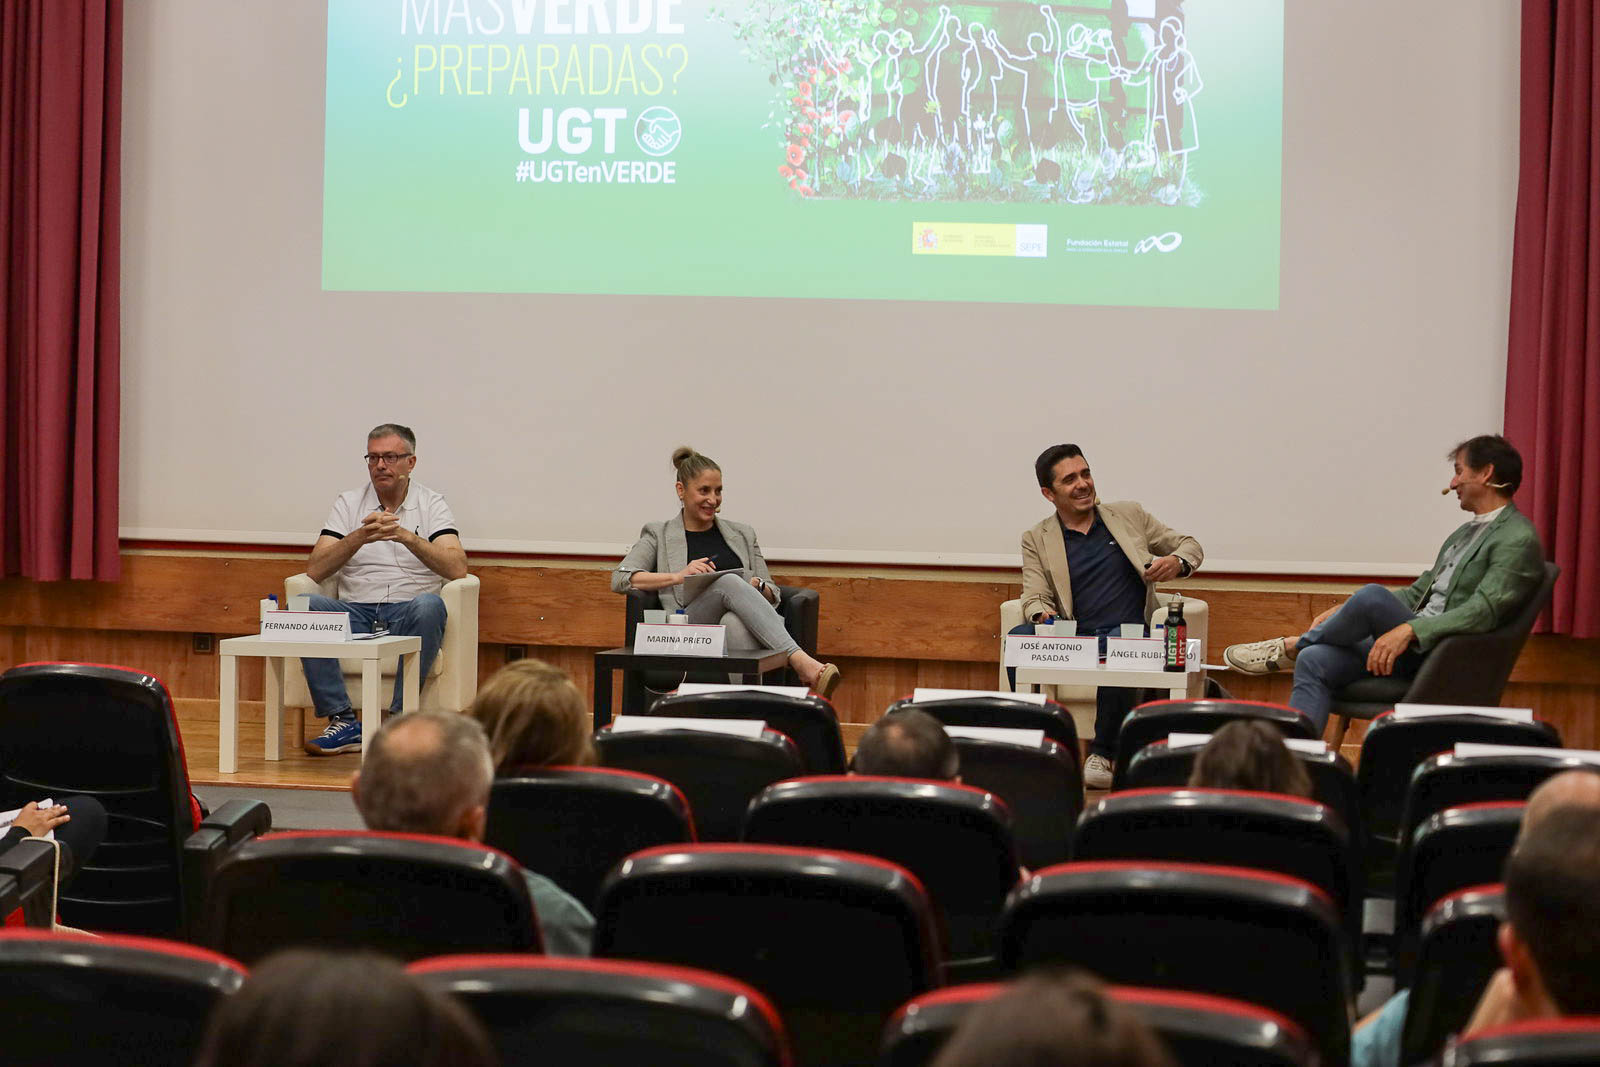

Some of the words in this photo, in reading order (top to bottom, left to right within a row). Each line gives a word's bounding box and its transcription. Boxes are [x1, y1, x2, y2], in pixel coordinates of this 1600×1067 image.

[386, 43, 689, 108] ¿PREPARADAS?
[518, 107, 628, 154] UGT
[515, 160, 677, 184] #UGTenVERDE
[1066, 238, 1103, 247] Fundación
[1103, 239, 1129, 248] Estatal
[265, 622, 308, 631] FERNANDO
[309, 621, 344, 632] ÁLVAREZ
[646, 635, 681, 644] MARINA
[683, 637, 712, 645] PRIETO
[1020, 641, 1040, 650] JOSÉ
[1041, 643, 1083, 651] ANTONIO
[1110, 649, 1139, 659] ÁNGEL
[1168, 640, 1177, 664] UGT
[1031, 654, 1070, 662] PASADAS
